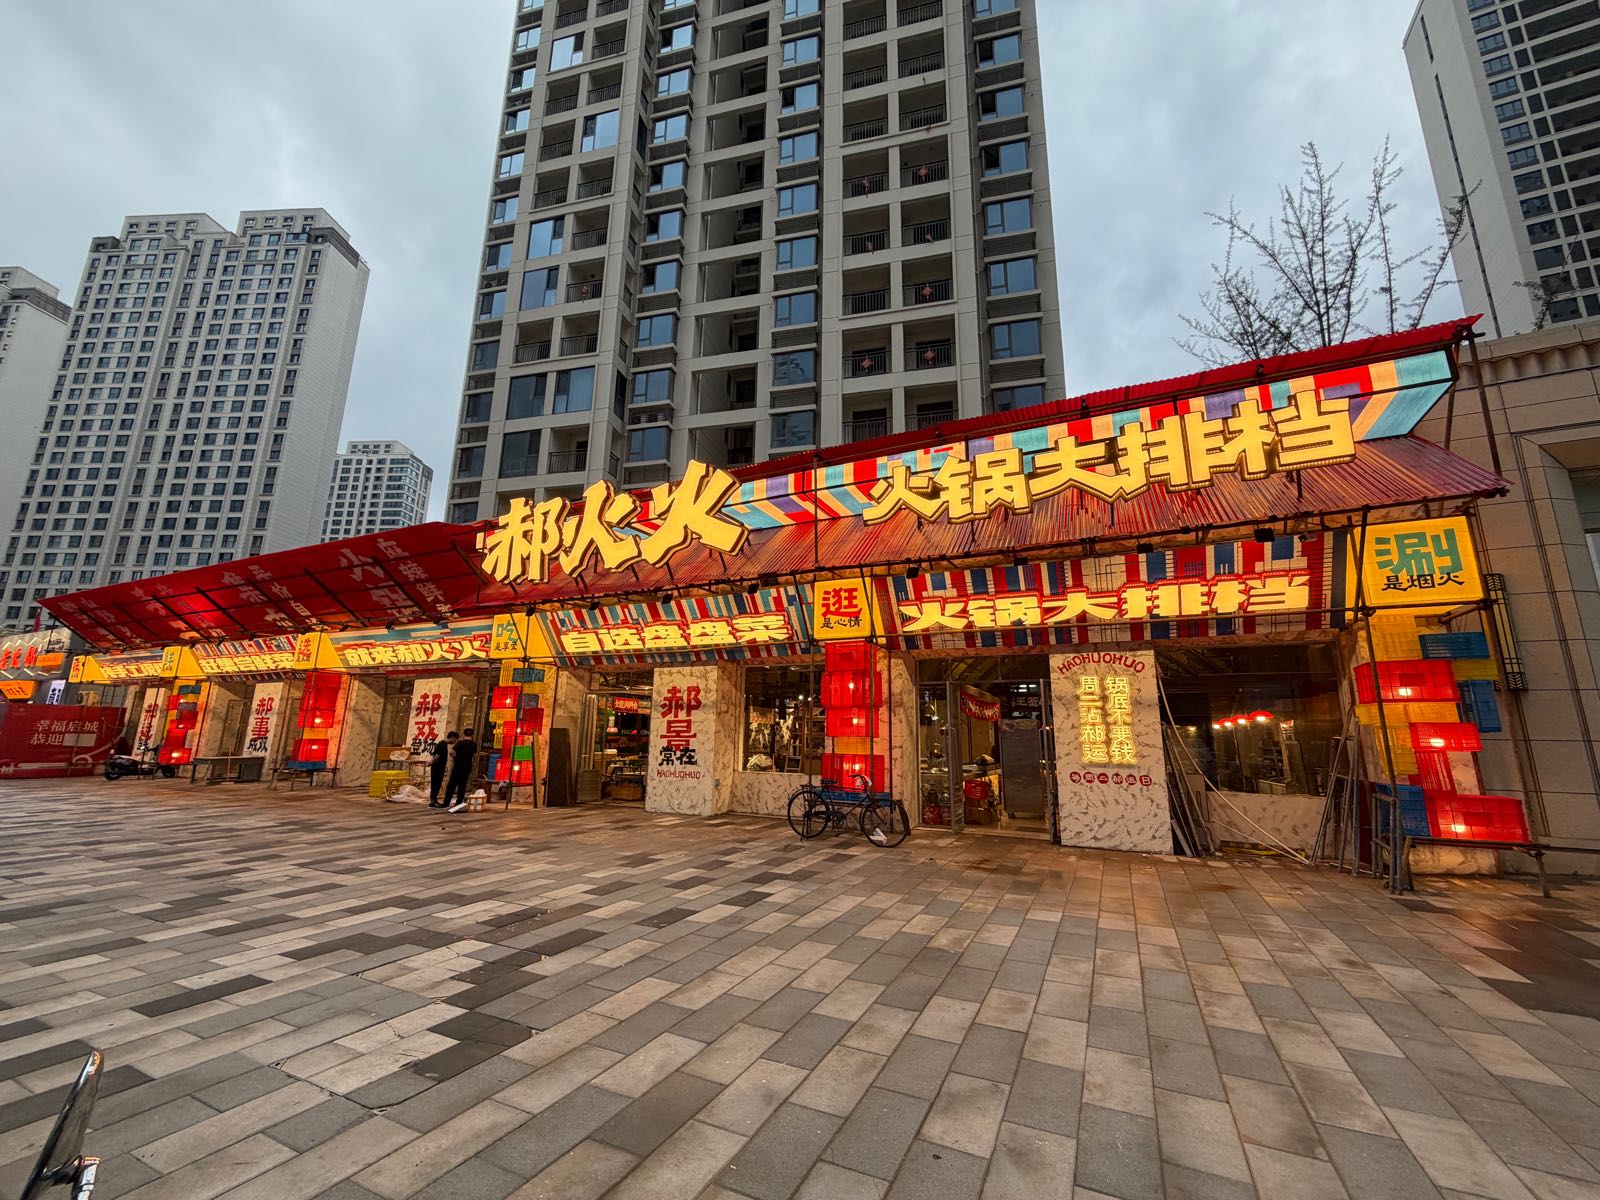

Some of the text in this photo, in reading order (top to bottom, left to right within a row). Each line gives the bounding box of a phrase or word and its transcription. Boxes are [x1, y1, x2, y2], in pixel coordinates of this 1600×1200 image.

[863, 391, 1355, 523] 火锅大排档
[481, 460, 749, 582] 郝火火
[1375, 521, 1463, 575] 涮
[1382, 573, 1465, 592] 是烟火
[821, 587, 862, 617] 逛
[900, 575, 1309, 631] 火锅大排档
[496, 619, 518, 643] 吃
[561, 615, 790, 653] 自选盘盘菜
[820, 617, 862, 629] 是心情
[343, 638, 488, 666] 就来郝火火
[1057, 653, 1145, 675] HAOHUOHUO
[1079, 676, 1108, 763] 周二沾郝运
[1105, 676, 1137, 764] 锅底不要钱
[658, 746, 697, 766] 常在
